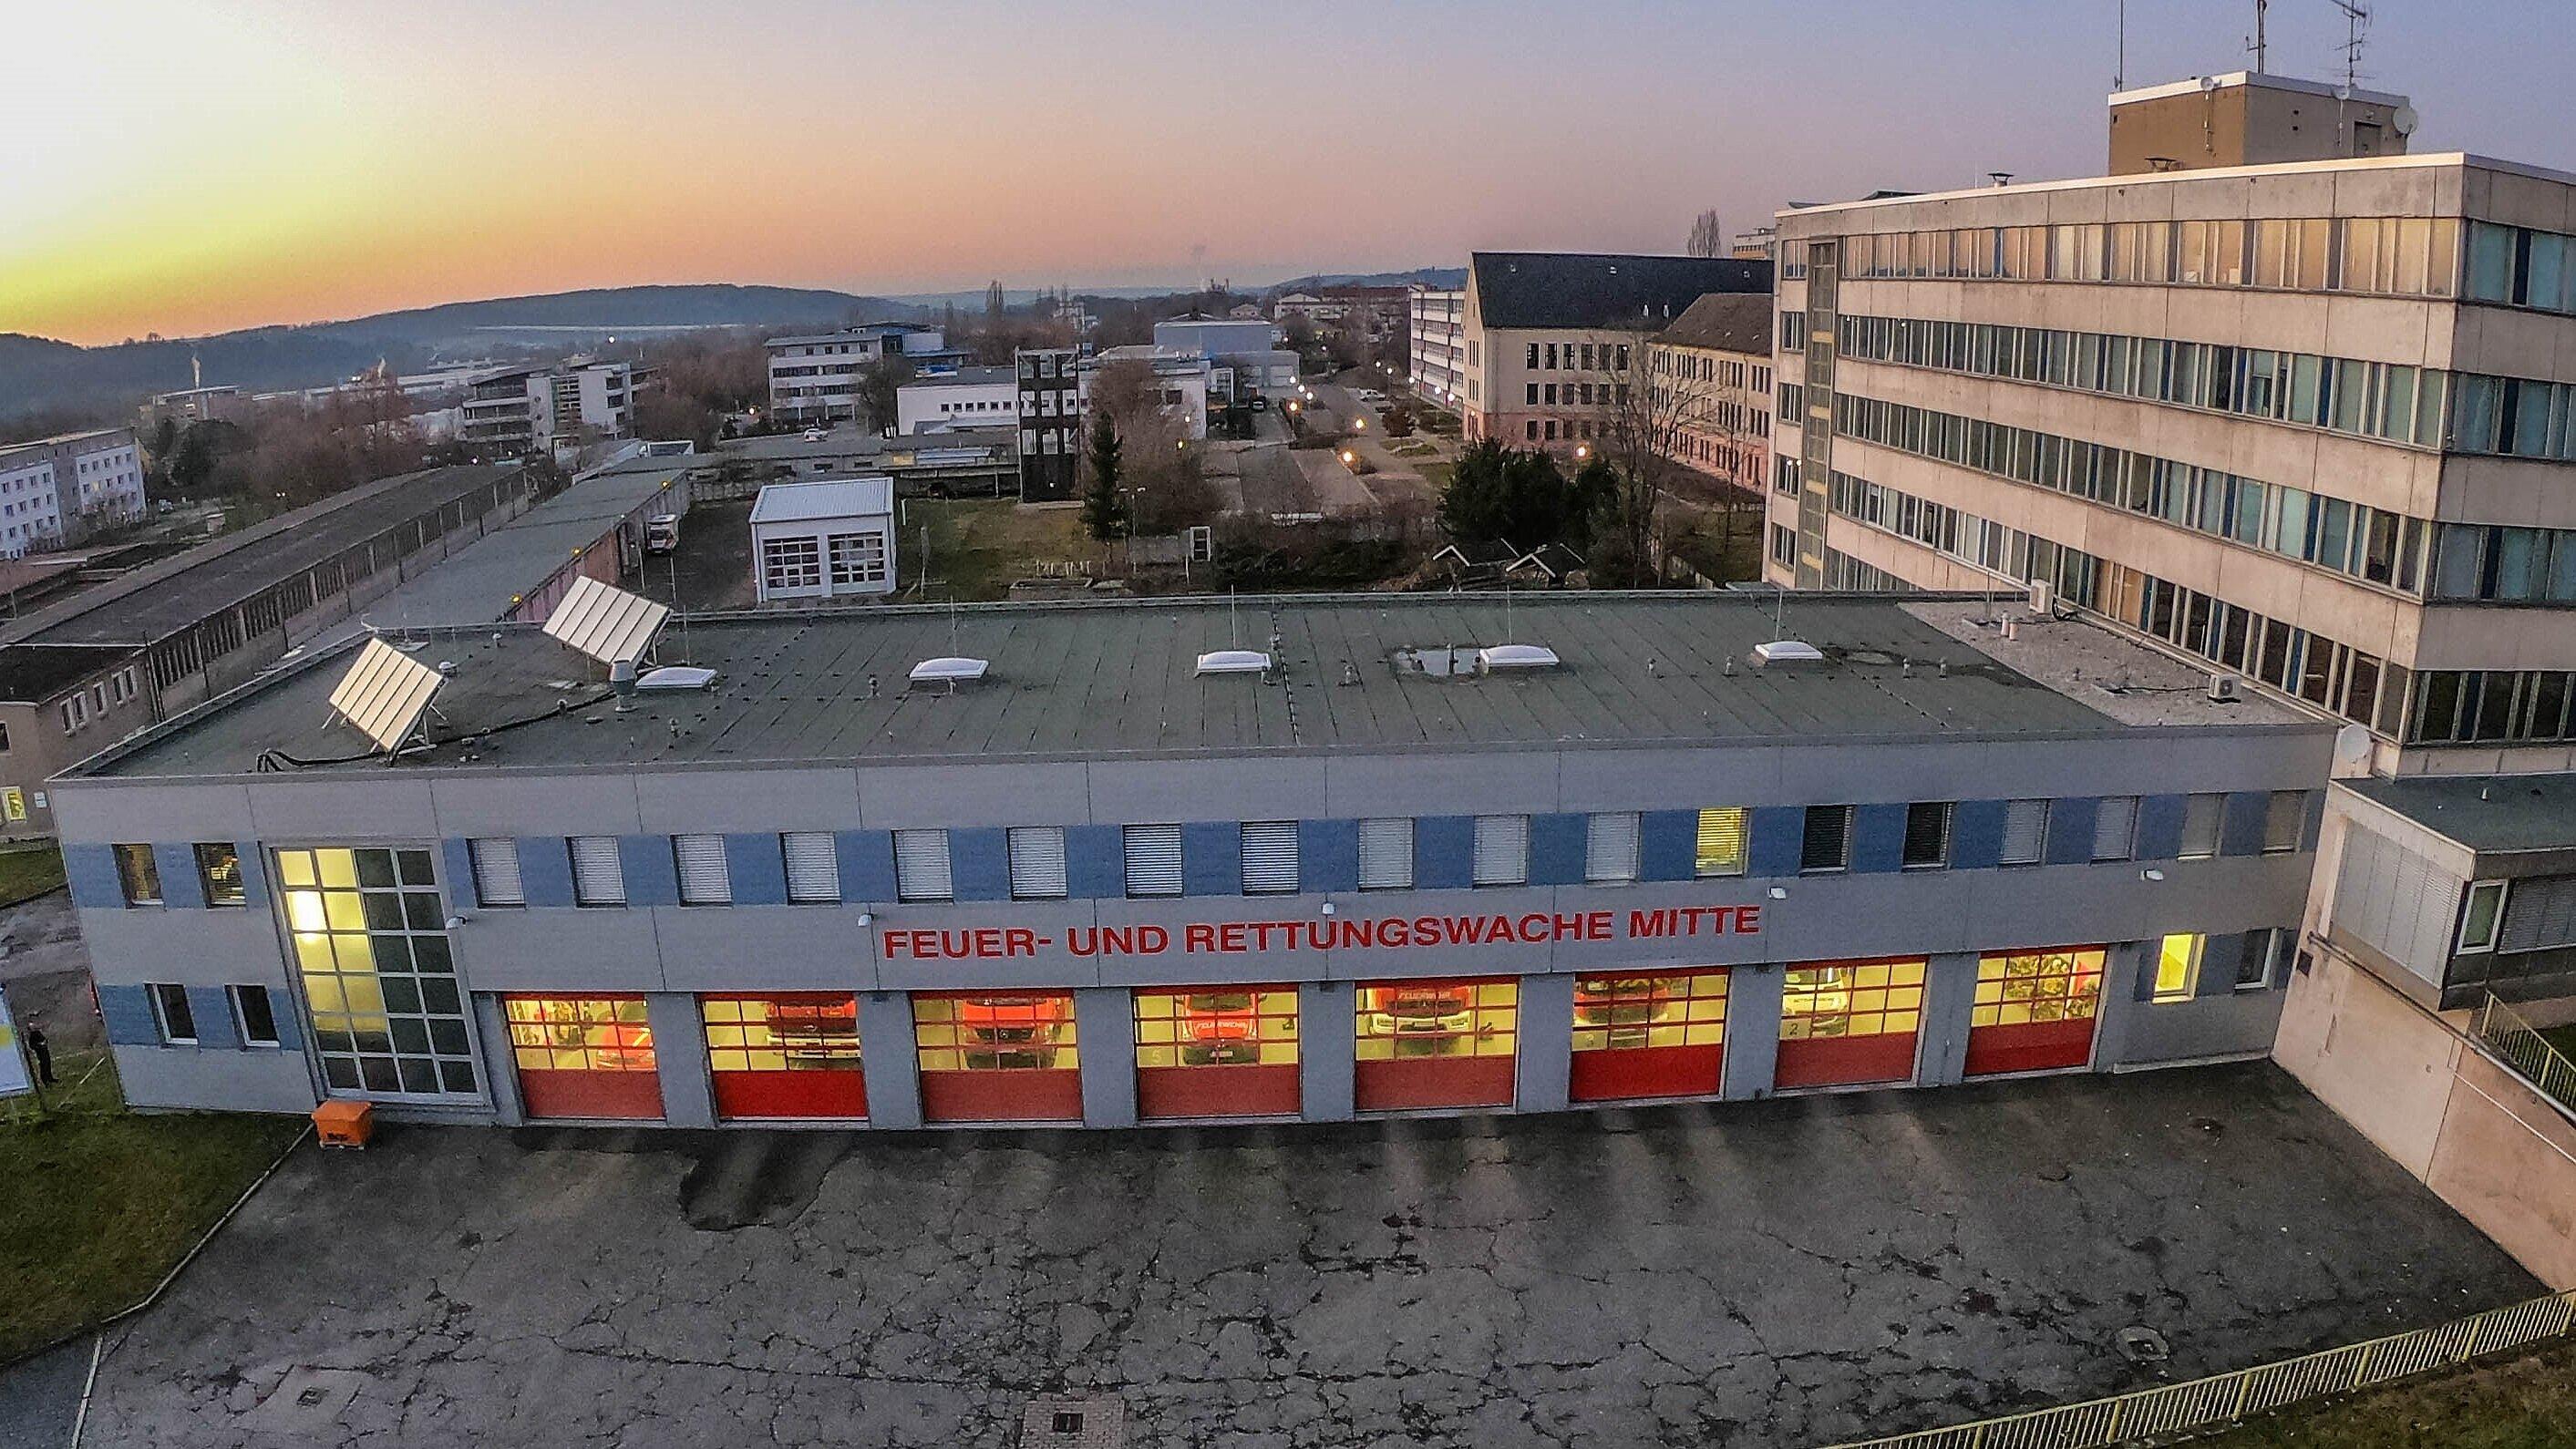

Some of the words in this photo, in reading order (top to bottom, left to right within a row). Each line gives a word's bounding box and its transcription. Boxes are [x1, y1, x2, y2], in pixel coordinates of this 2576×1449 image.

[883, 929, 1052, 959] FEUER-
[1067, 926, 1170, 956] UND
[1185, 911, 1613, 953] RETTUNGSWACHE
[1629, 905, 1760, 938] MITTE
[1789, 1023, 1798, 1036] 2
